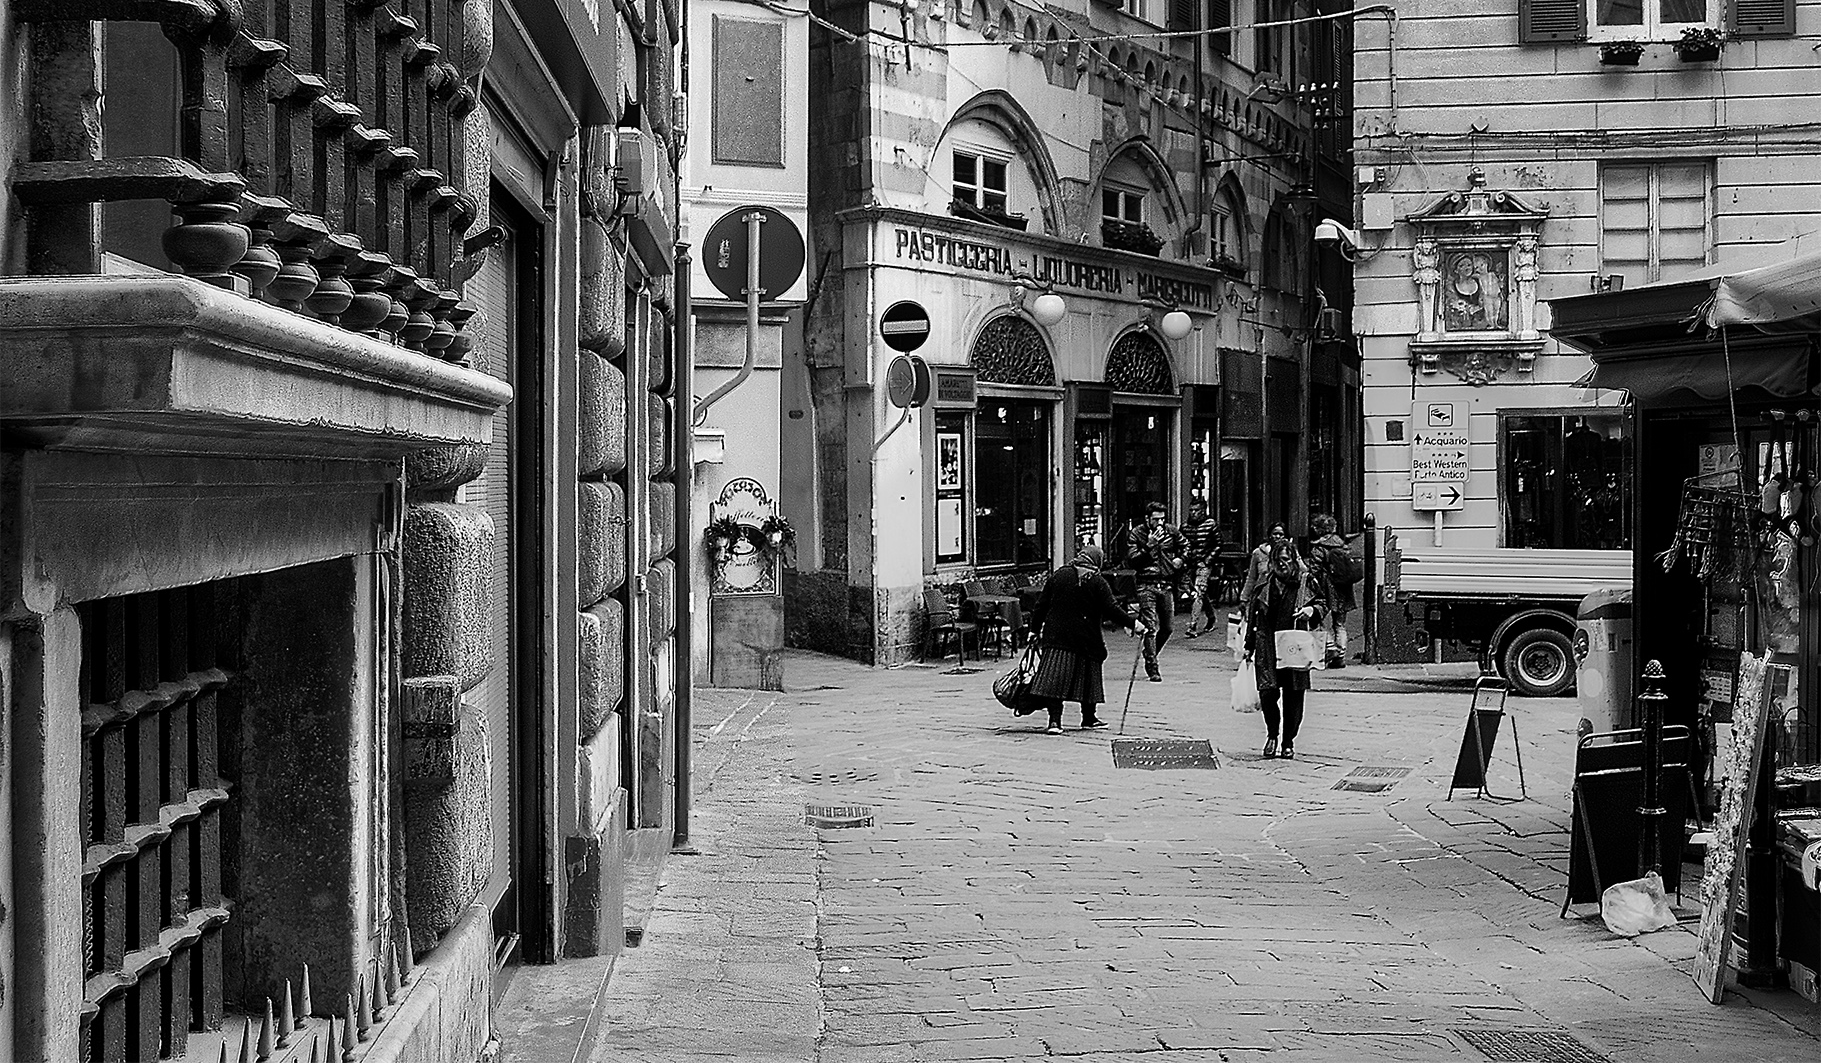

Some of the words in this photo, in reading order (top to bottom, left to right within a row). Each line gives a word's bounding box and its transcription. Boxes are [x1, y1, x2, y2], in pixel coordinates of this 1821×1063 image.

[895, 228, 1013, 276] PASTICCERIA
[1033, 254, 1122, 294] LIQUORERIA
[1423, 435, 1468, 446] Acquario
[1413, 459, 1431, 469] Best
[1433, 459, 1468, 469] Western
[1439, 469, 1465, 479] Antico
